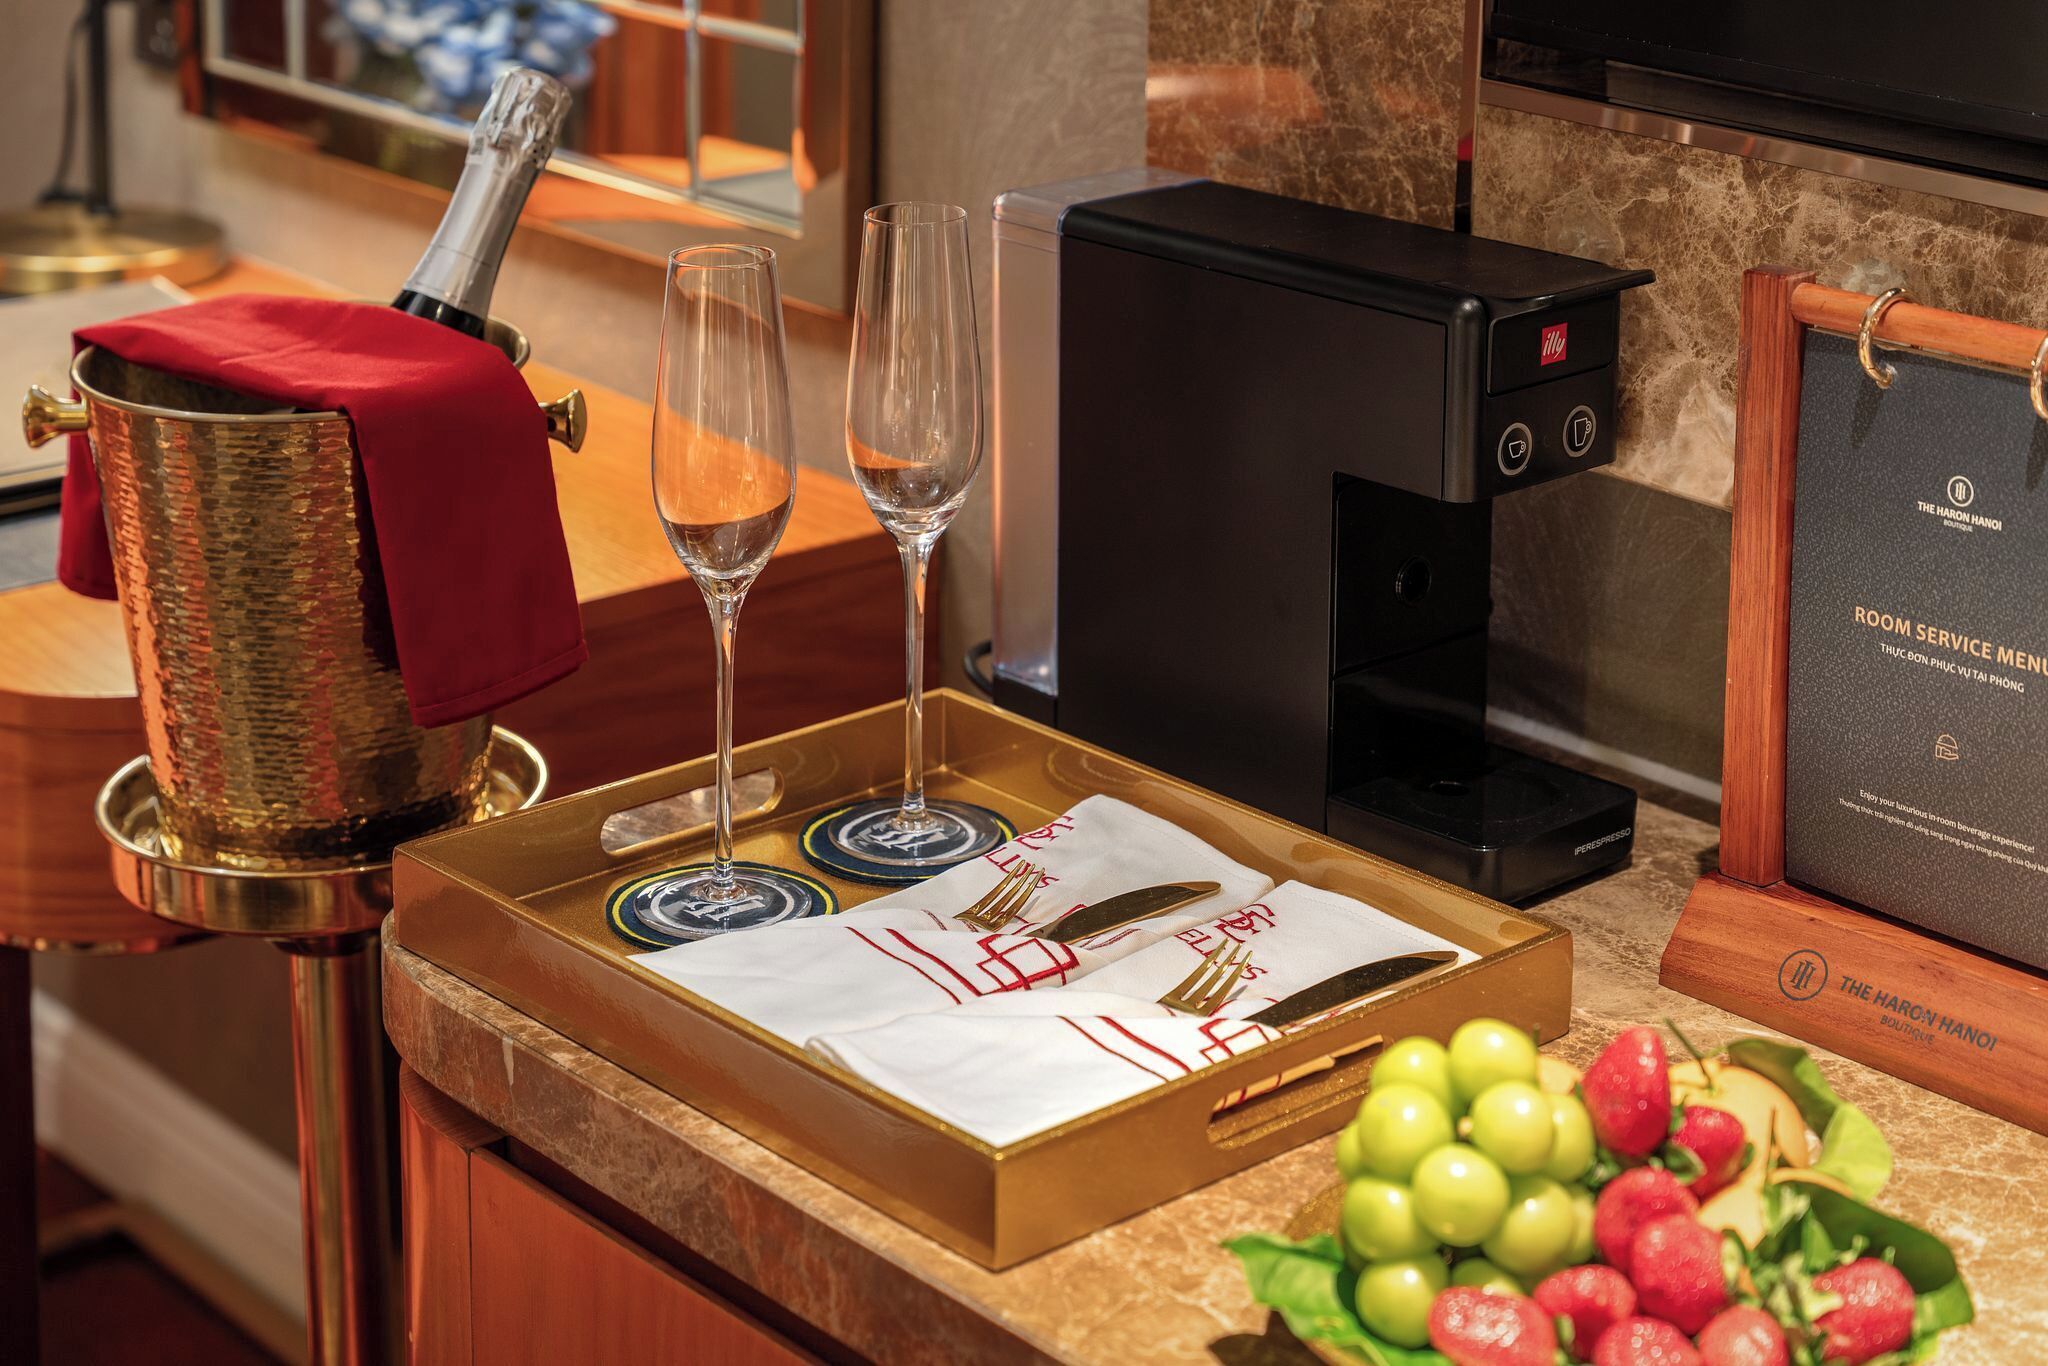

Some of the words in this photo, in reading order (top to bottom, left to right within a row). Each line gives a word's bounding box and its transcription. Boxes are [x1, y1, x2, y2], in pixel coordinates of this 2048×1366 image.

[1542, 330, 1566, 359] illy
[1917, 501, 1936, 515] THE
[1937, 506, 1970, 523] HARON
[1971, 514, 2003, 531] HANOI
[1943, 519, 1974, 533] BOUTIQUE
[1855, 606, 1911, 637] ROOM
[1916, 623, 1992, 660] SERVICE
[1880, 643, 1906, 659] THỰC
[1907, 651, 1929, 665] ĐƠN
[1930, 658, 1957, 673] PHỤC
[1957, 666, 1971, 679] VỤ
[1972, 670, 1988, 683] TẠI
[1989, 674, 2025, 693] PHÒNG
[1860, 790, 1879, 803] Enjoy
[1879, 797, 1895, 807] your
[1896, 801, 1928, 819] luxurious
[1928, 812, 1957, 829] in-room
[1957, 821, 1991, 840] beverage
[1992, 834, 2035, 854] experience!
[1574, 827, 1632, 856] IPERESPRESSO
[1840, 975, 1873, 1001] THE
[1872, 990, 1940, 1027] HARON
[1939, 1016, 1999, 1052] HANOI
[1879, 1014, 1936, 1046] BOUTIQUE
